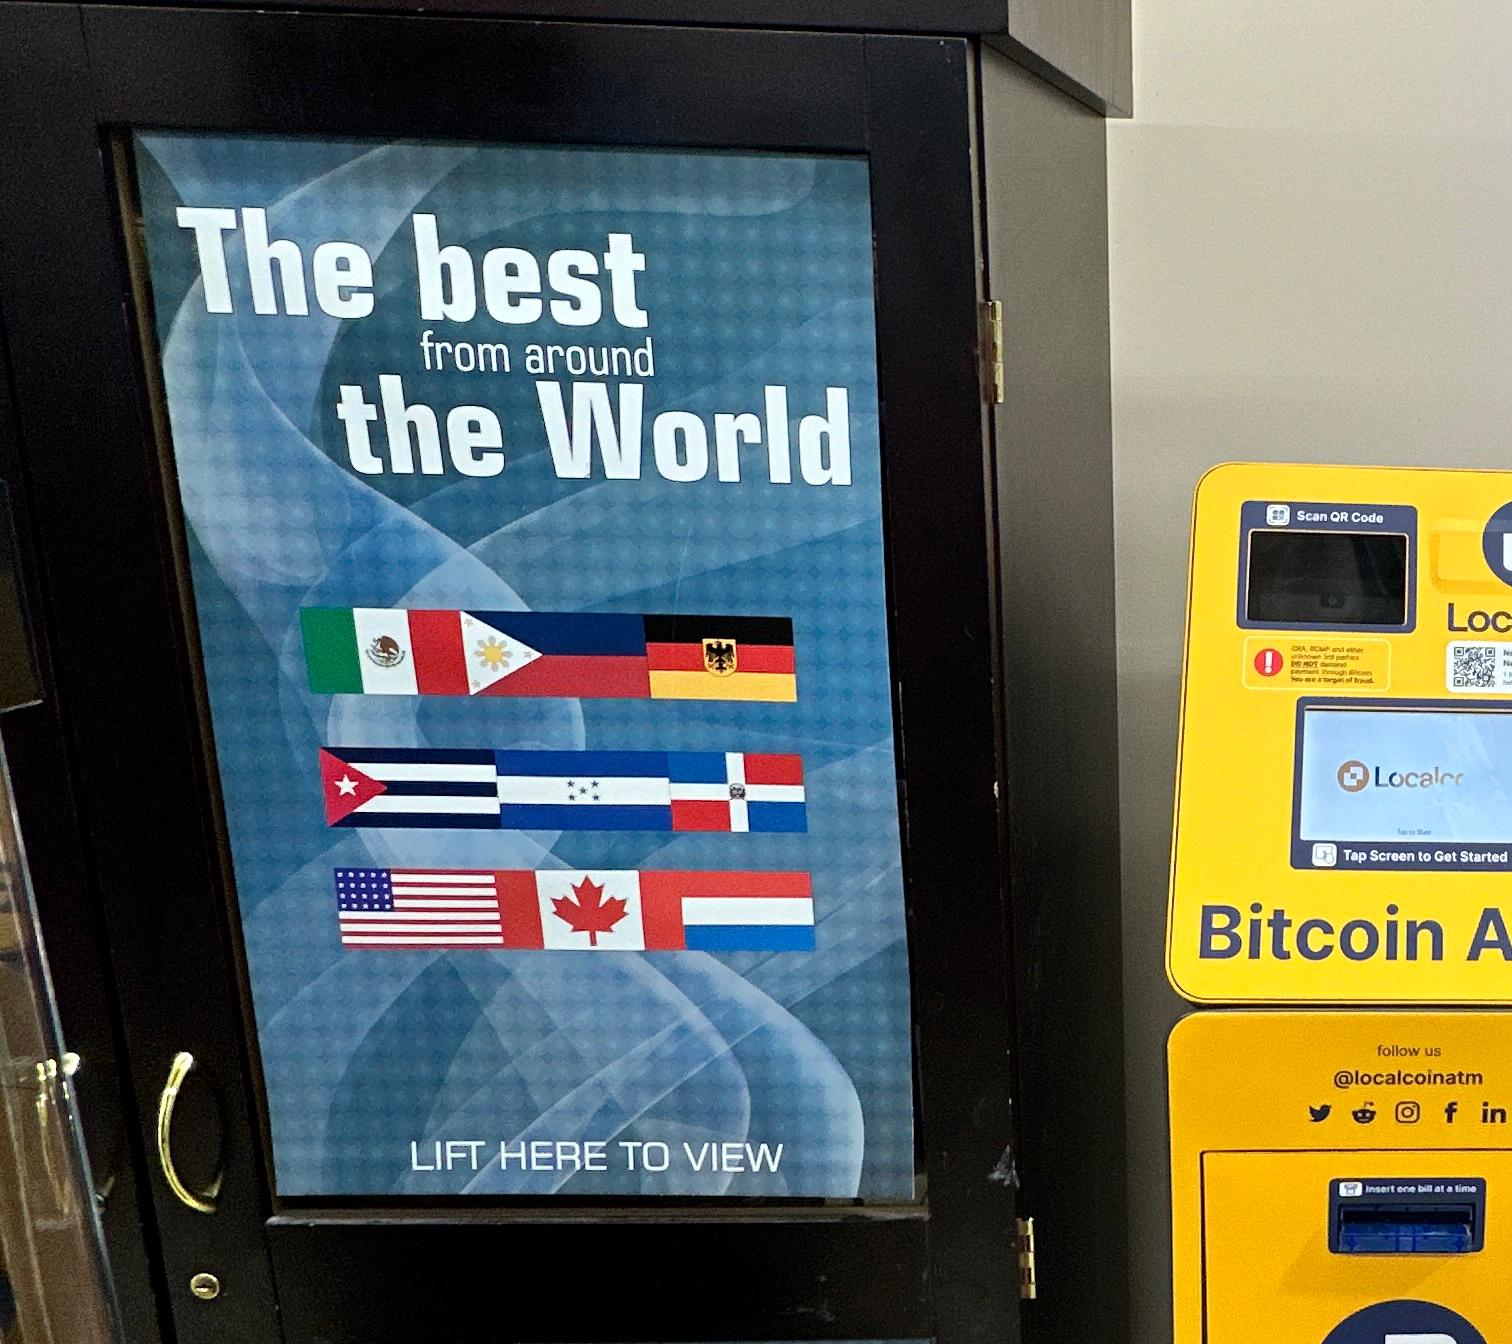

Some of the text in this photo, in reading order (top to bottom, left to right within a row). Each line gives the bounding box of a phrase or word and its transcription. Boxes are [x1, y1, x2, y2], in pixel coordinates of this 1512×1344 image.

[176, 205, 648, 328] The best
[421, 331, 655, 378] from around
[336, 376, 852, 486] the World
[1296, 510, 1384, 524] Scan QR Code
[1343, 850, 1508, 864] Tap Screen to Get Started
[1198, 902, 1443, 962] Bitcoin
[1377, 1044, 1442, 1056] follow us
[1334, 1069, 1483, 1088] @localcoinatm
[411, 1140, 784, 1174] LIFT HERE TO VIEW
[1365, 1184, 1395, 1193] Insert
[1397, 1185, 1416, 1193] one
[1418, 1184, 1433, 1193] bill
[1434, 1184, 1445, 1193] at
[1455, 1184, 1477, 1193] time
